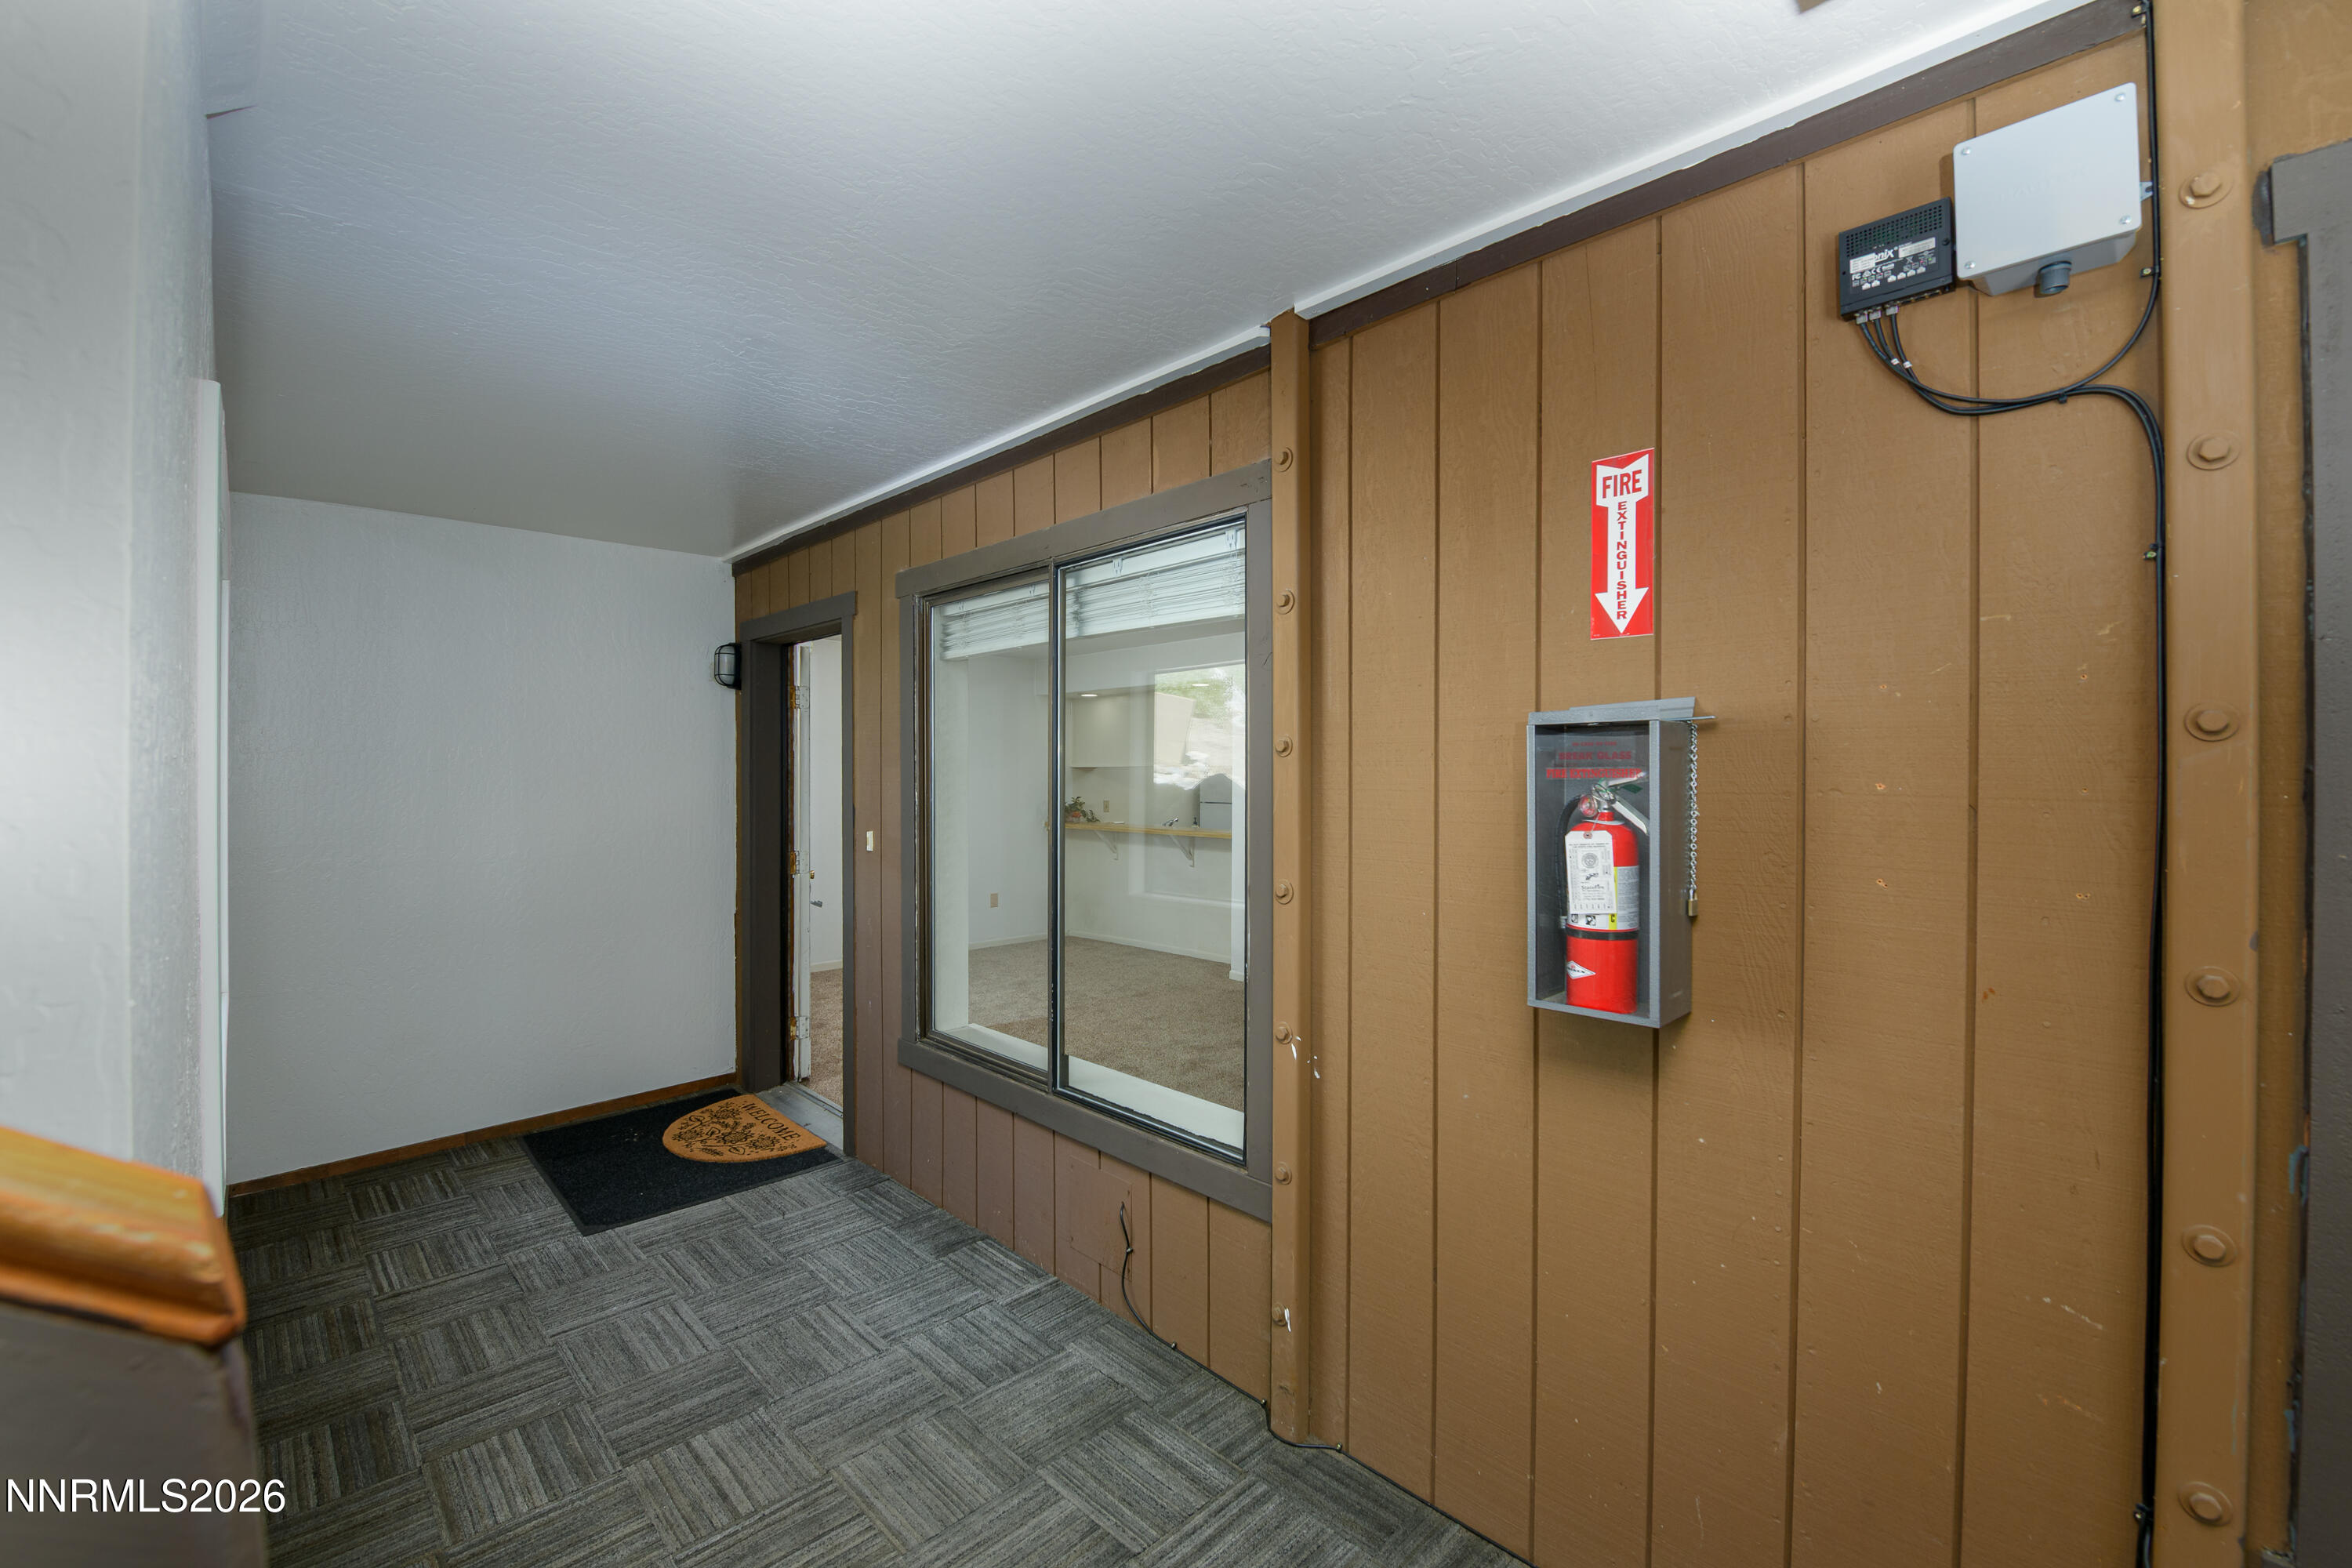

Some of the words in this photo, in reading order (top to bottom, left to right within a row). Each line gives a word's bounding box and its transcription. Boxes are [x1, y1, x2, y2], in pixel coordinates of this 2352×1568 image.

[1602, 470, 1642, 499] FIRE
[1616, 501, 1628, 620] EXTINGUISHER
[1546, 768, 1567, 778] FIRE
[741, 1103, 800, 1141] WELCOME
